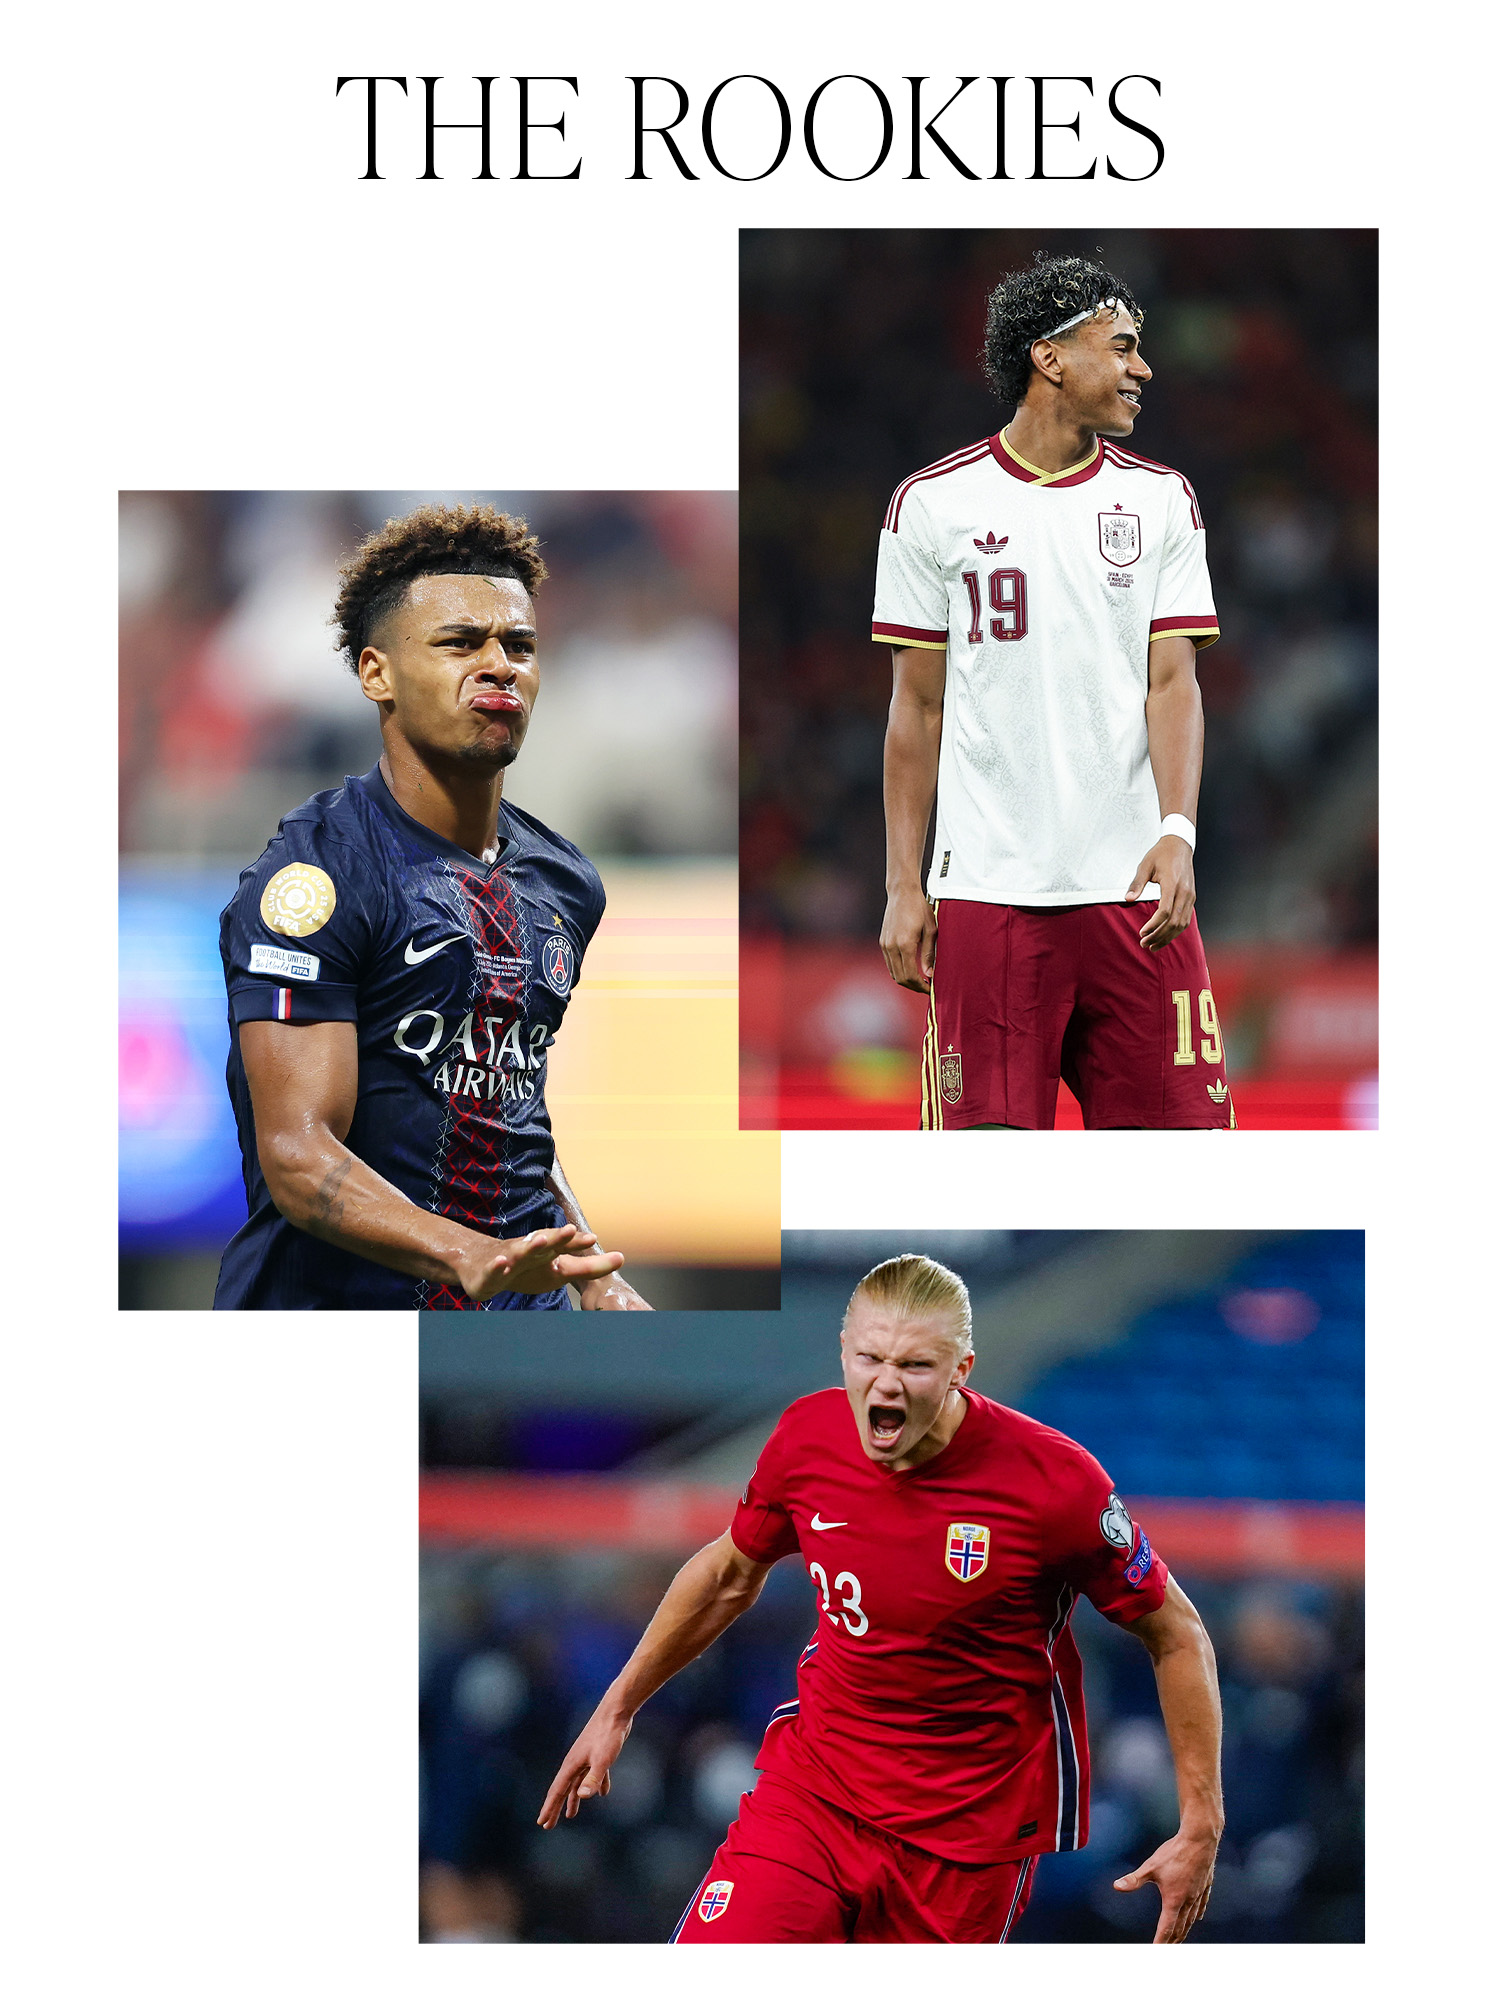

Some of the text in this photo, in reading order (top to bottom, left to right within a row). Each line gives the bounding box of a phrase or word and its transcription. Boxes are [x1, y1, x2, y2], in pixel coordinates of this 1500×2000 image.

[961, 567, 1028, 645] 19
[275, 870, 310, 886] WORLD
[311, 875, 327, 892] CUP
[267, 888, 277, 912] CLUB
[273, 914, 300, 933] FIFA
[305, 908, 325, 925] USA
[547, 938, 570, 955] PARIS
[256, 948, 312, 966] FOOTBALL UNITES
[291, 966, 309, 976] FIFA
[1171, 988, 1223, 1066] 19
[393, 1009, 548, 1071] QATAR
[433, 1061, 536, 1101] AIRWAYS
[809, 1561, 869, 1637] 23
